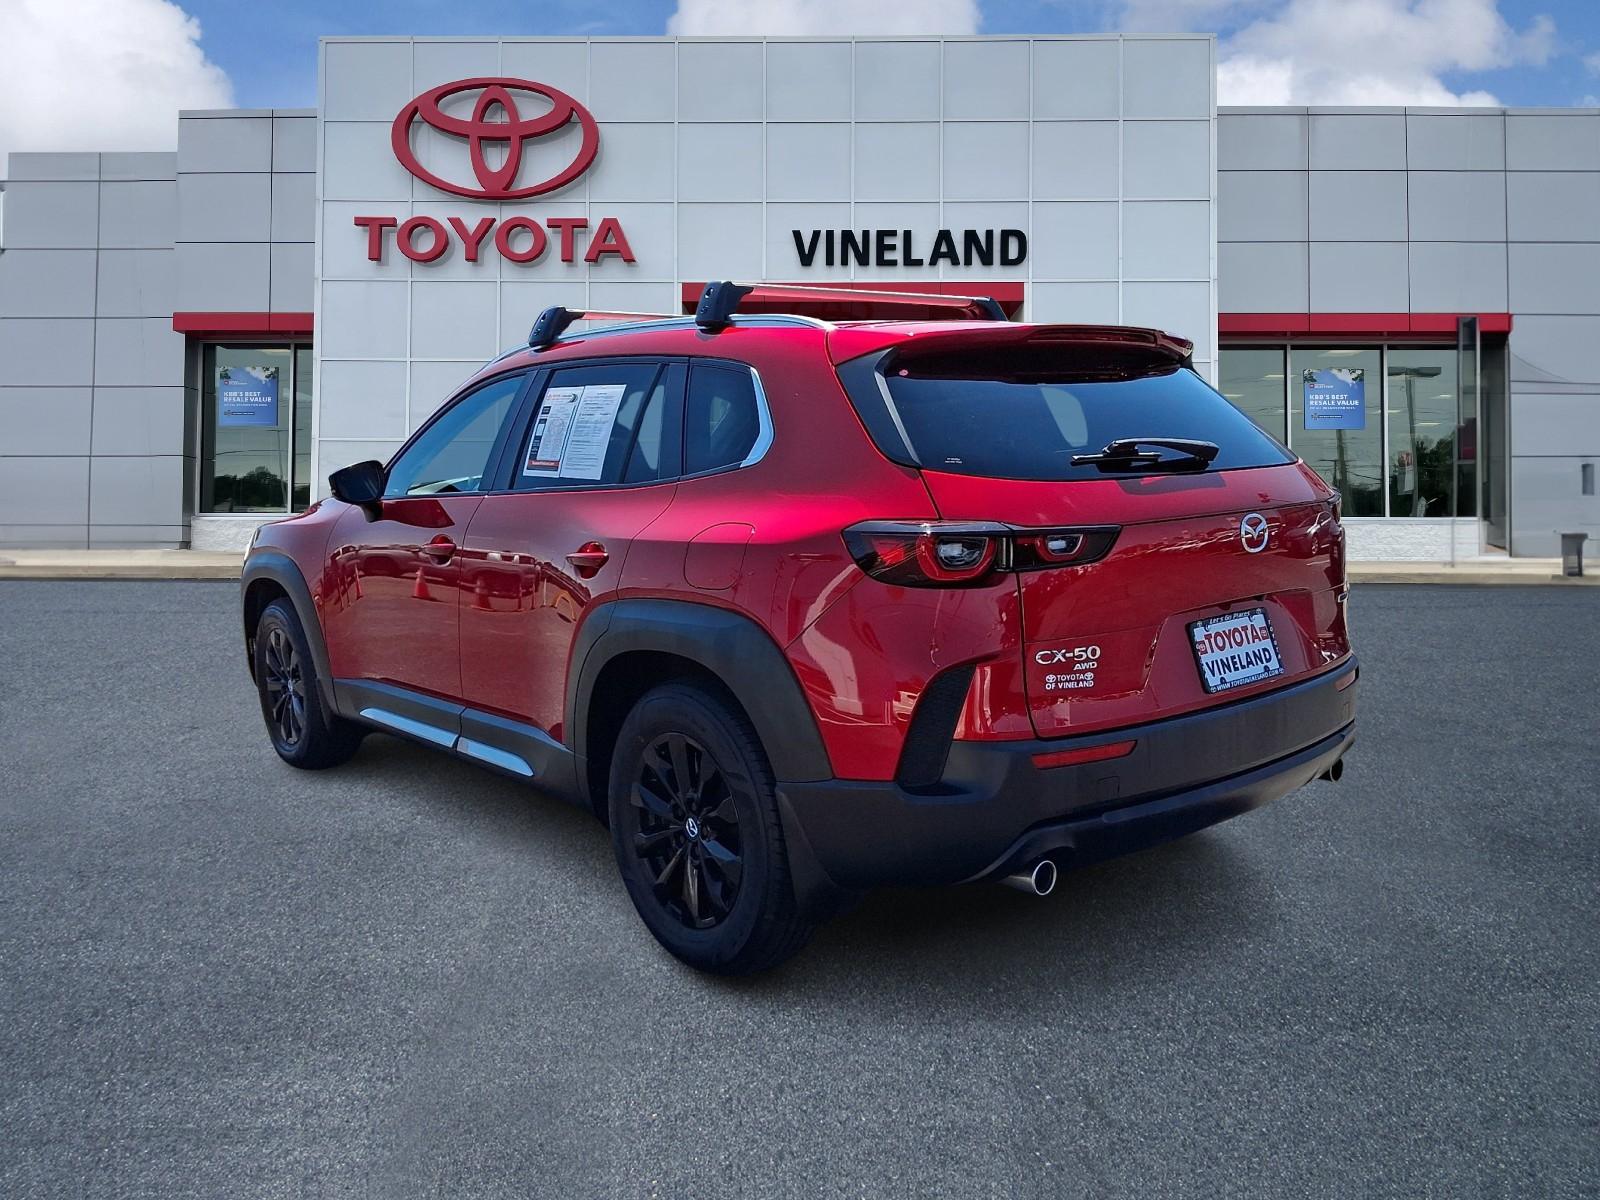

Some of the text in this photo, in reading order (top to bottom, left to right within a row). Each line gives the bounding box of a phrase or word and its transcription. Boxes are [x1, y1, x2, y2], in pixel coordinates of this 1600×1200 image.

[354, 216, 636, 263] TOYOTA
[792, 229, 1027, 266] VINELAND
[1203, 623, 1262, 654] TOYOTA
[1035, 645, 1101, 665] CX-50
[1073, 661, 1098, 671] AWD
[1205, 647, 1272, 678] VINELAND
[1045, 680, 1094, 690] OF VINELAND
[1056, 673, 1085, 681] TOYOTA
